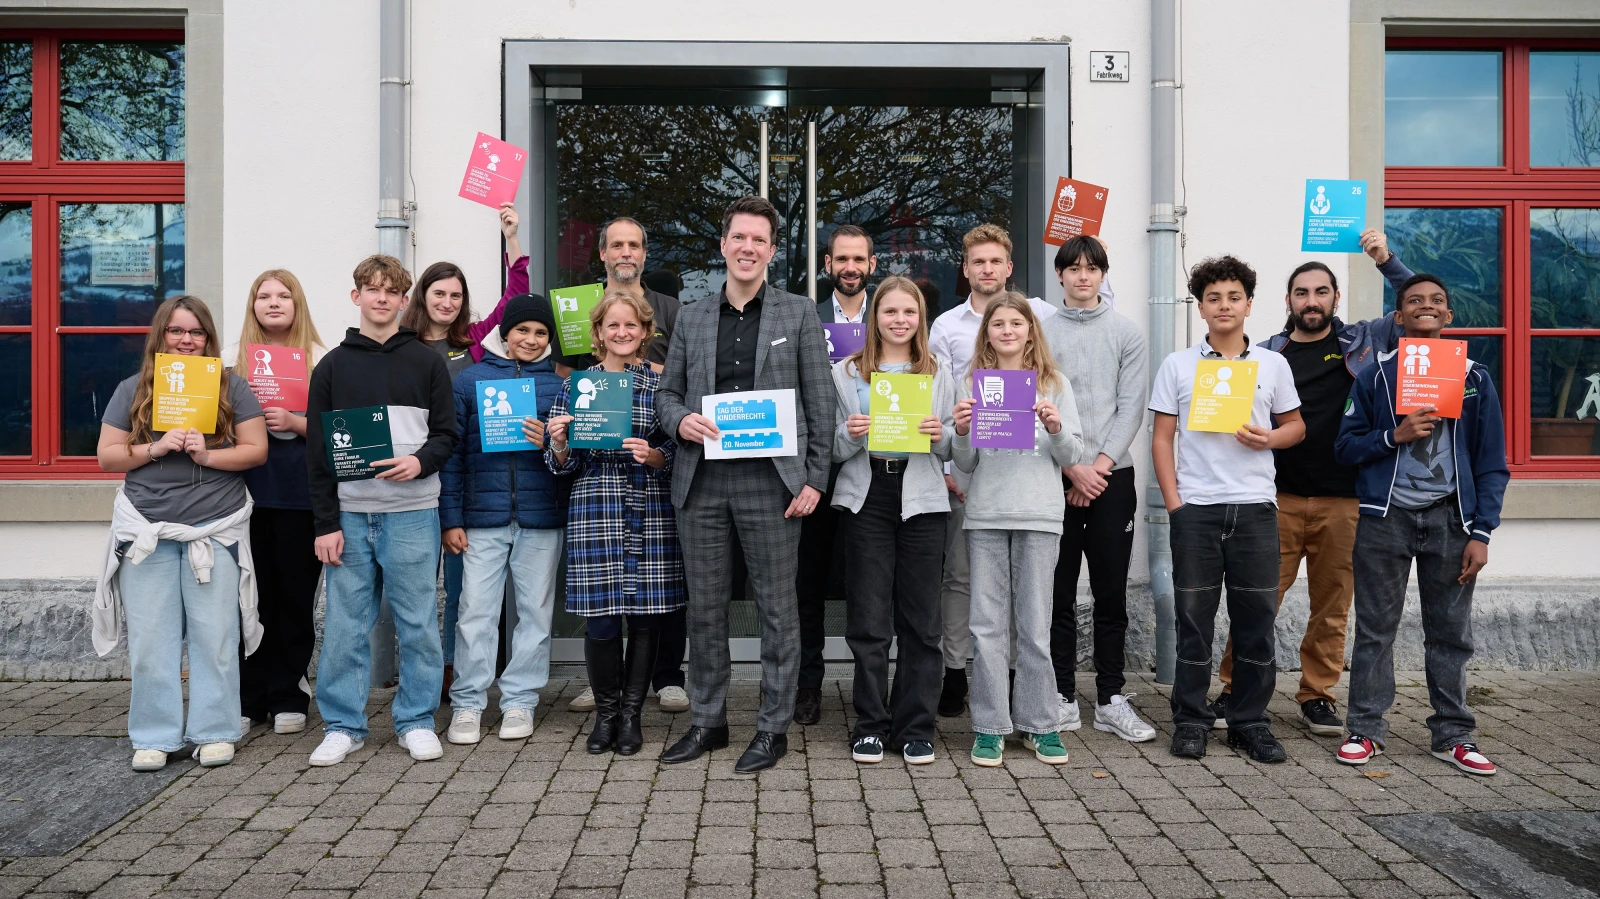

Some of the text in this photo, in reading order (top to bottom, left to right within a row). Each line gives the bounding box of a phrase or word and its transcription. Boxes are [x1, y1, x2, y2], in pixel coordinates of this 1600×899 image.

[1105, 55, 1114, 71] 3
[1097, 71, 1122, 80] Fabrikweg
[1095, 192, 1103, 200] 42
[1456, 347, 1461, 355] 2
[206, 364, 215, 372] 15
[619, 379, 628, 387] 13
[919, 382, 927, 390] 14
[1026, 378, 1031, 386] 4
[373, 413, 383, 421] 20
[717, 413, 766, 421] KINDERRECHTE
